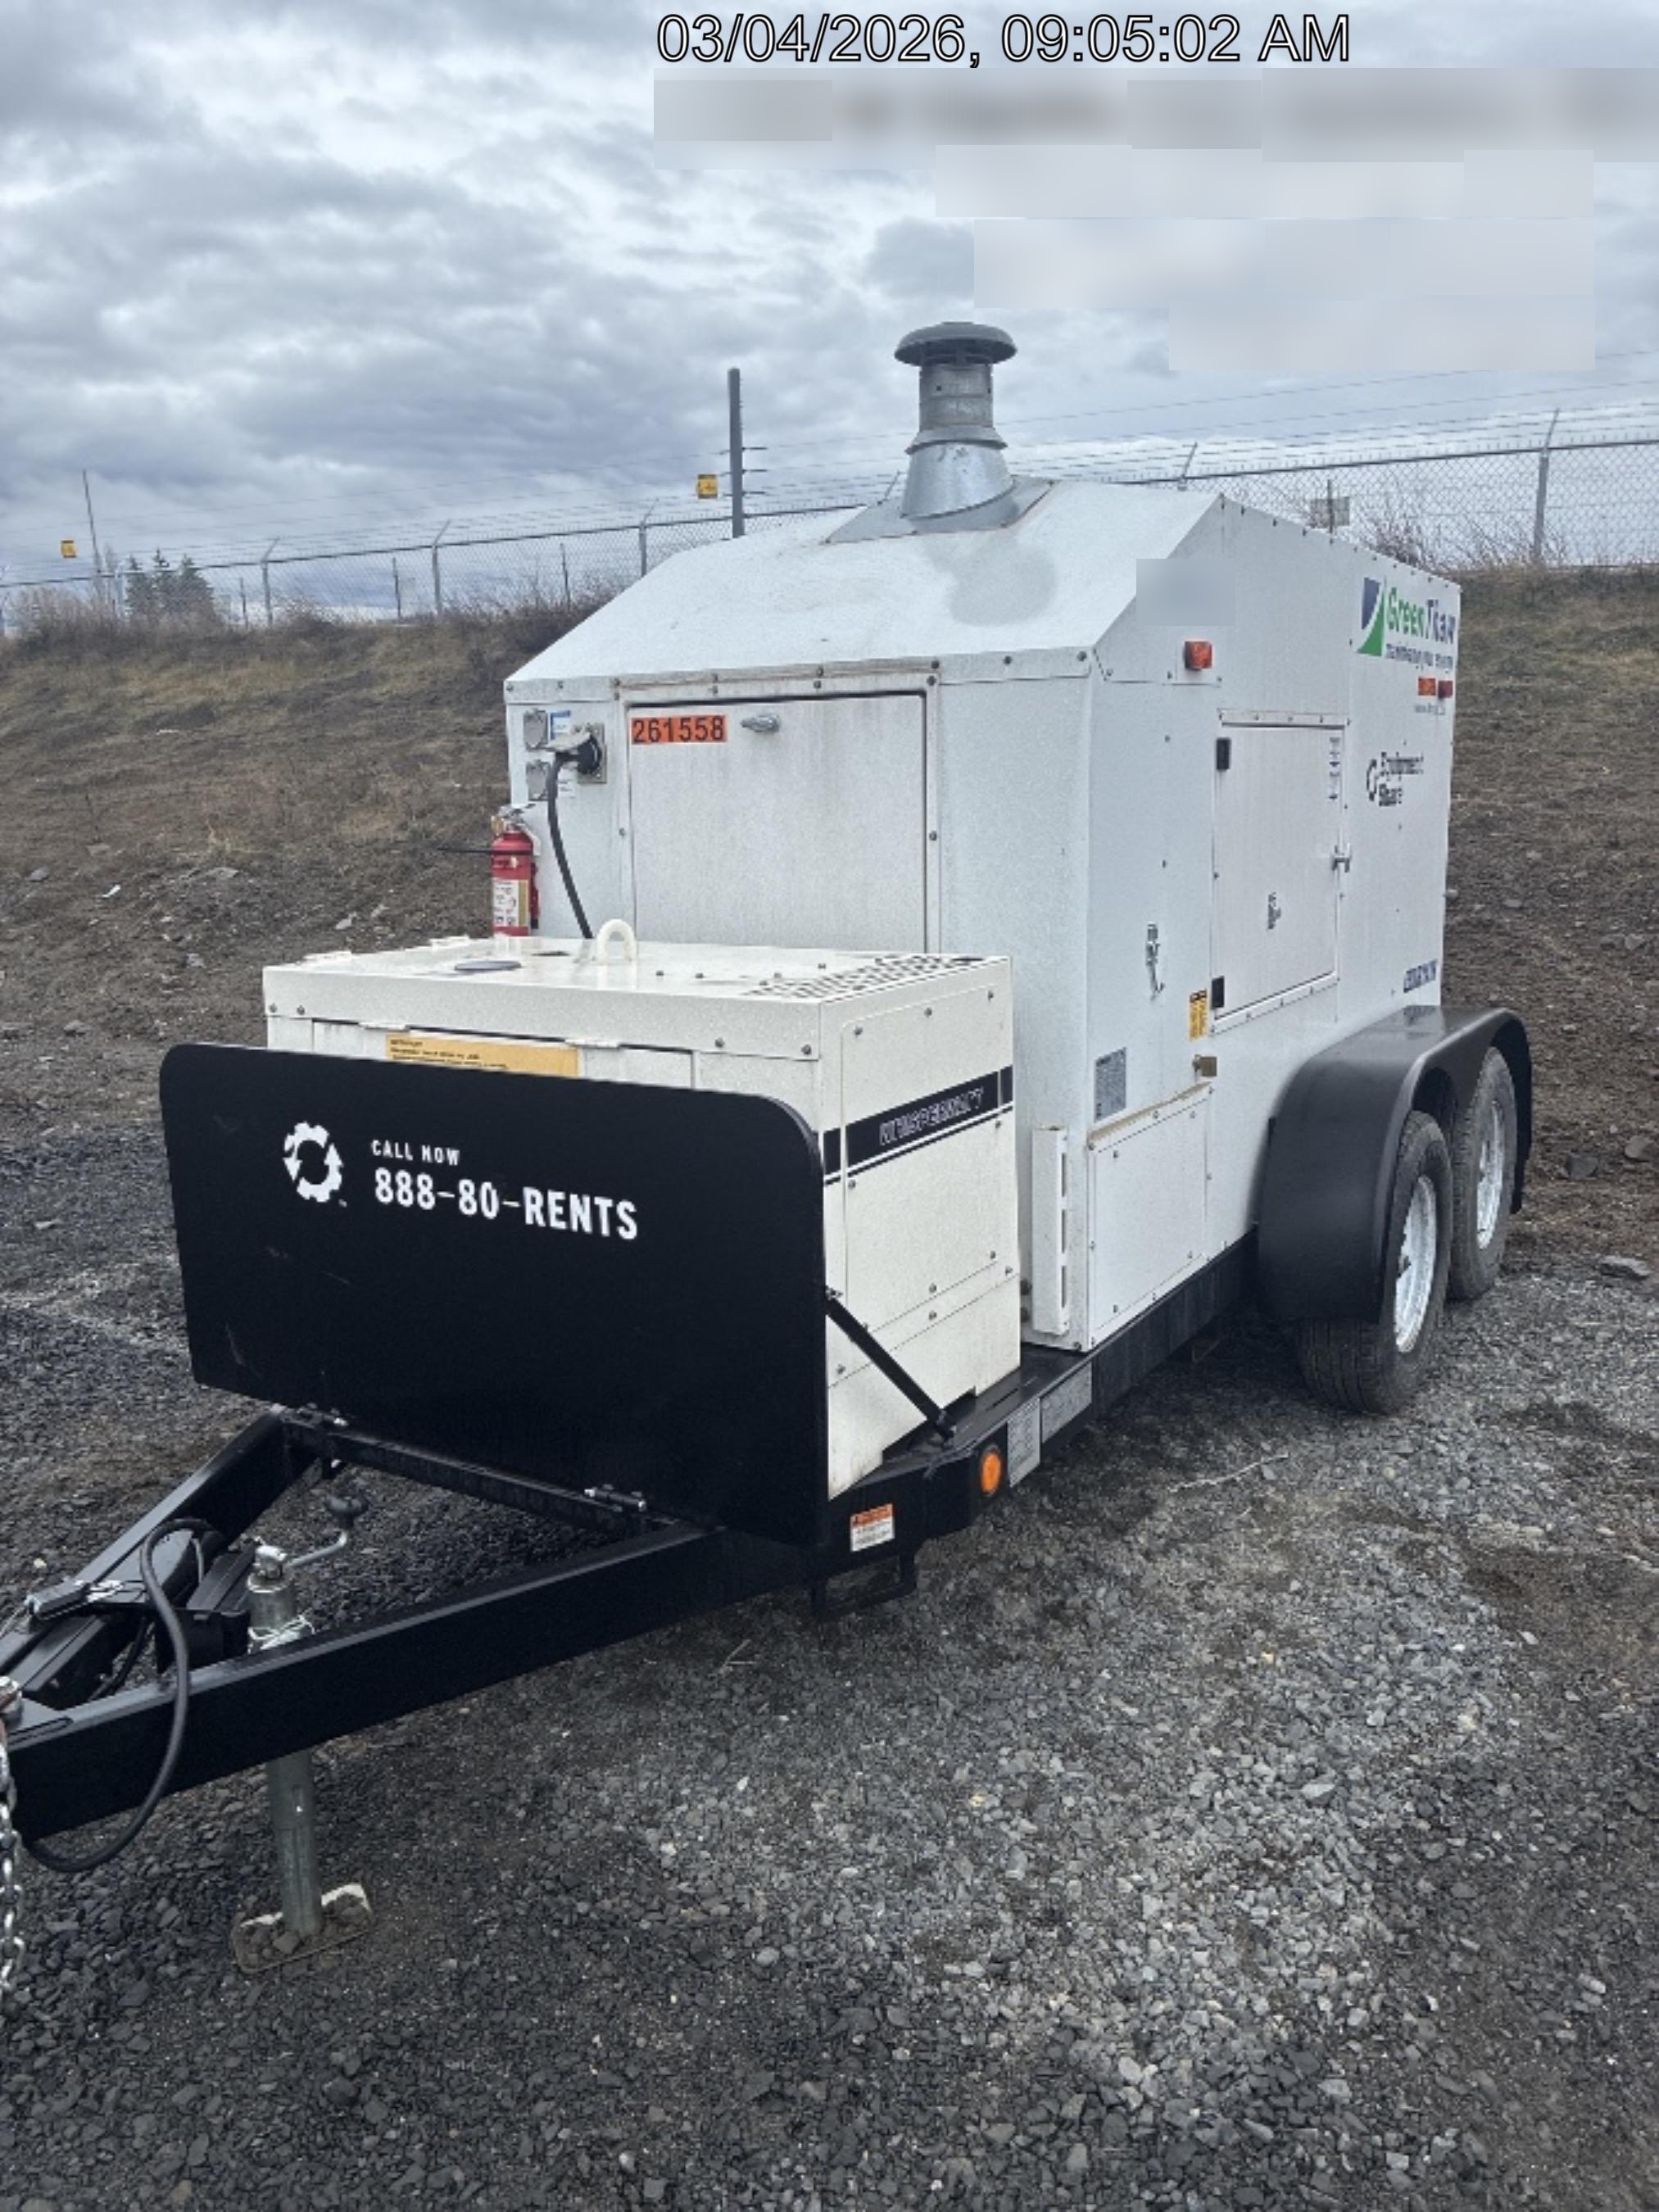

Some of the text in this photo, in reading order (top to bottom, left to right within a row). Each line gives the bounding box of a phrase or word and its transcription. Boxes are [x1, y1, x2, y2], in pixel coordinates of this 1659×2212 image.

[632, 715, 724, 743] 261558
[370, 1139, 460, 1166] CALL NOW
[374, 1167, 638, 1240] 888-80-RENTS
